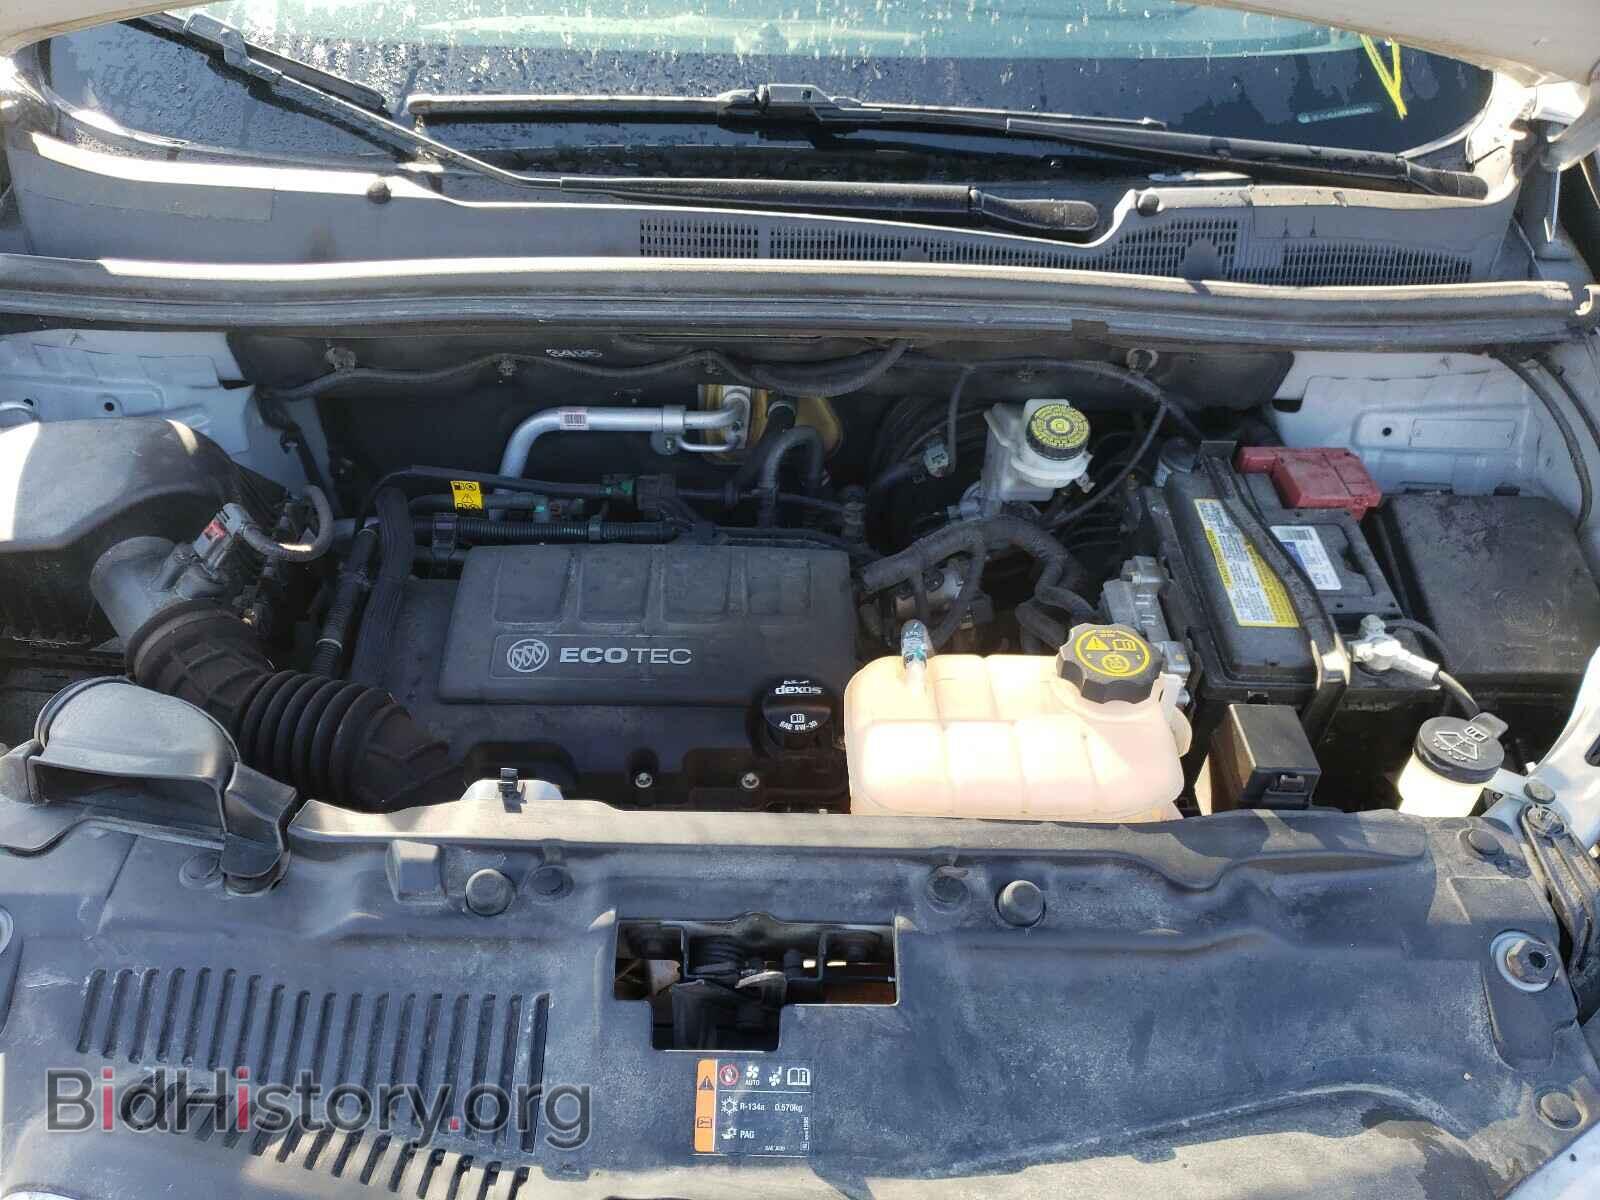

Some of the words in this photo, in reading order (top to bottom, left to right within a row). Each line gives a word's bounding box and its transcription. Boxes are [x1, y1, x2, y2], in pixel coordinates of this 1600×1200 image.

[559, 647, 692, 665] ECOTEC
[775, 684, 824, 695] dexos
[740, 1102, 765, 1111] R-134a
[774, 1102, 803, 1113] 0.570kg
[740, 1130, 755, 1139] PAG
